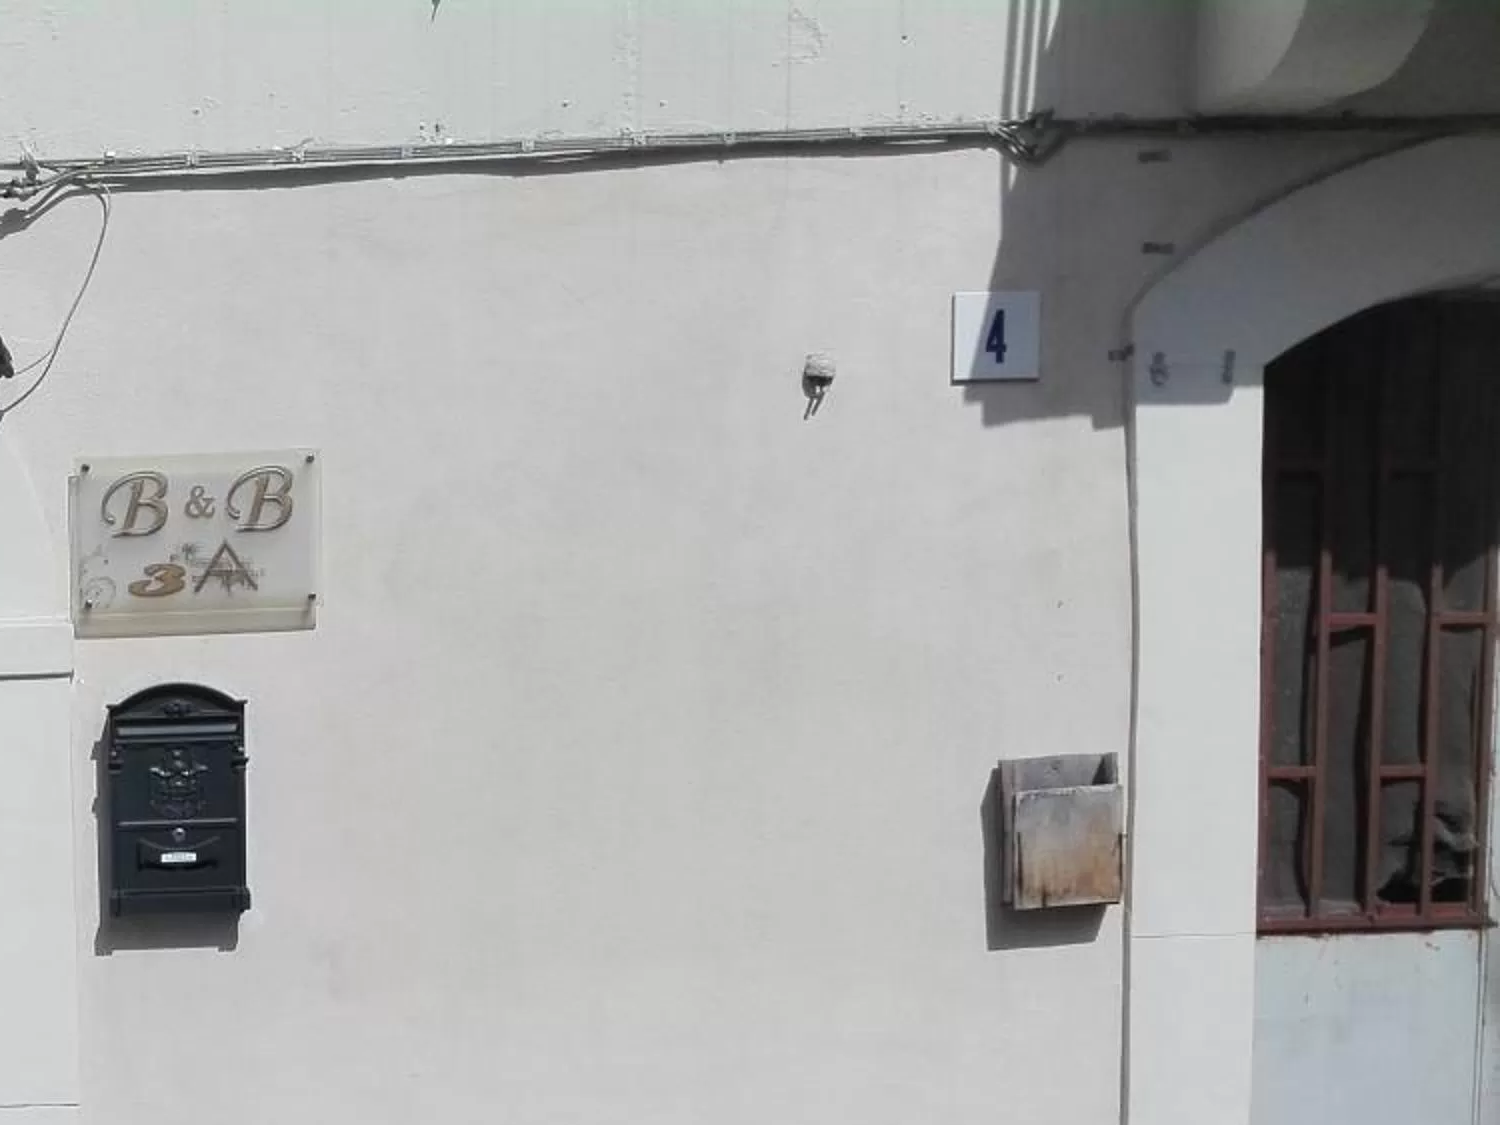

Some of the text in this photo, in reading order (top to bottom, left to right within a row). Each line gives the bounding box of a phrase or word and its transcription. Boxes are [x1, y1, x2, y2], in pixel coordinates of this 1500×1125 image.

[985, 308, 1007, 364] 4
[101, 465, 293, 539] B & B
[127, 539, 258, 597] 3A
